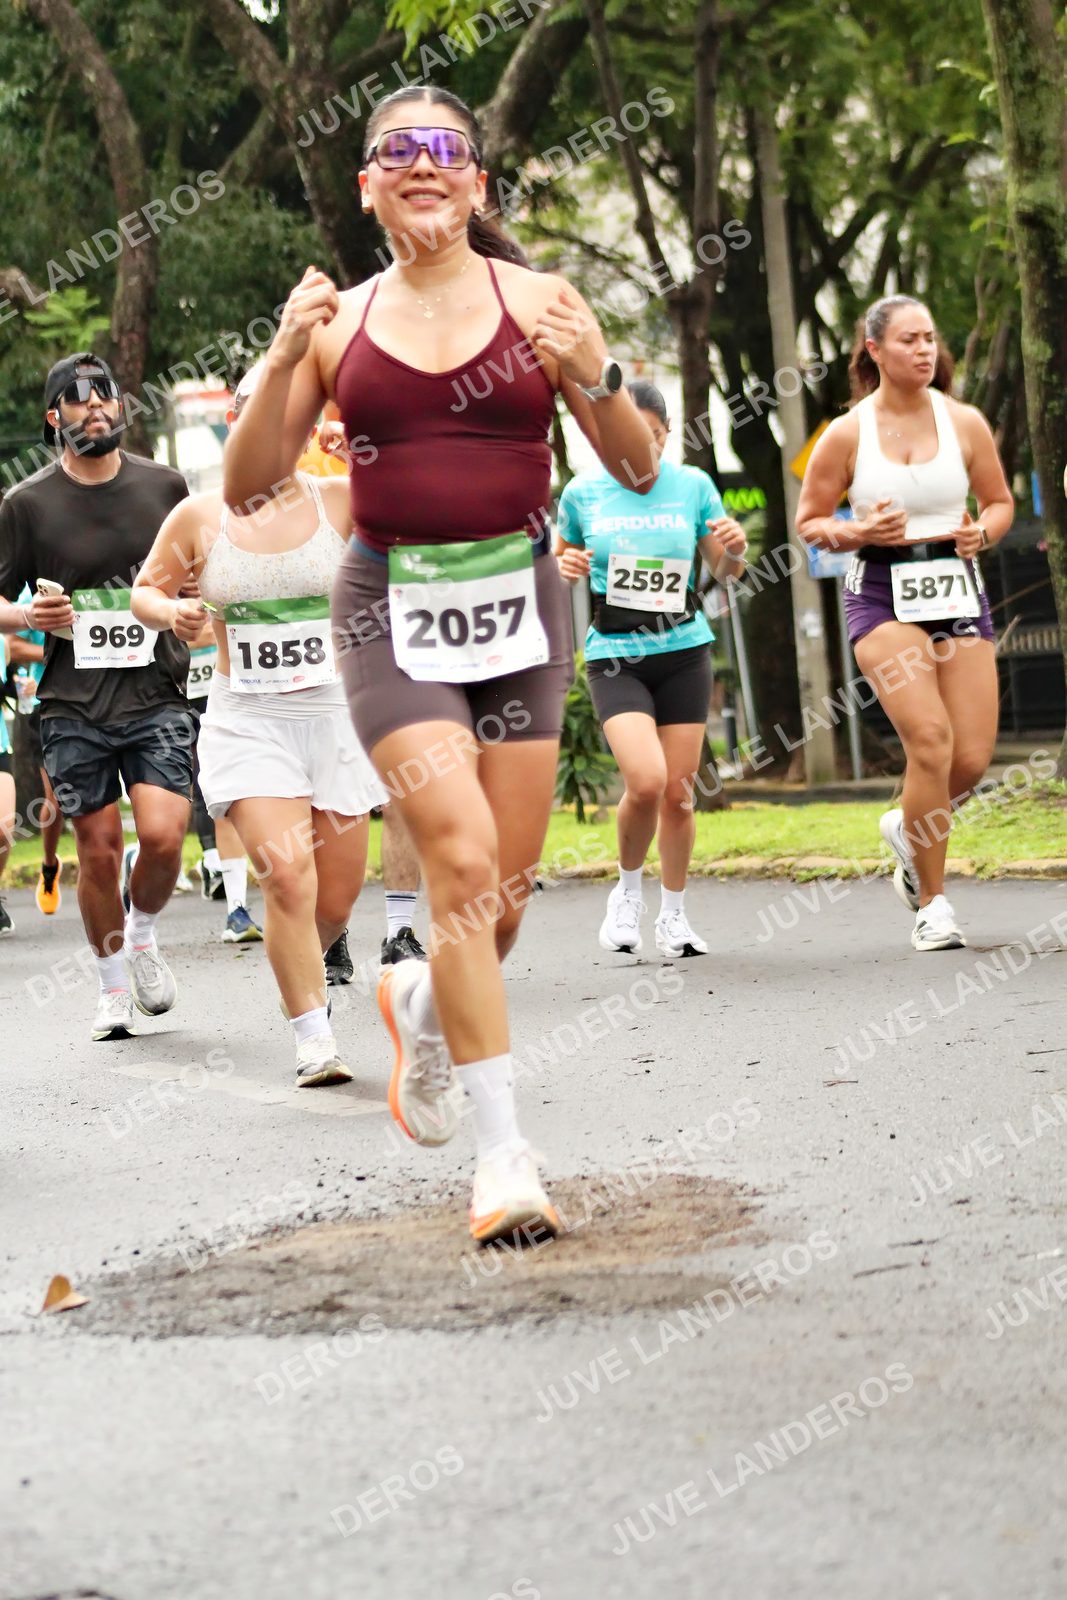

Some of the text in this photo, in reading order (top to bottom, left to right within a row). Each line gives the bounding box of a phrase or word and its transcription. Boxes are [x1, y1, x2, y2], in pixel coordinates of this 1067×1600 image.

[591, 513, 687, 532] PERDURA
[613, 568, 681, 593] 2592
[900, 574, 968, 601] 5871
[403, 595, 526, 648] 2057
[89, 624, 145, 648] 969
[237, 637, 326, 669] 1858
[189, 664, 216, 684] 39
